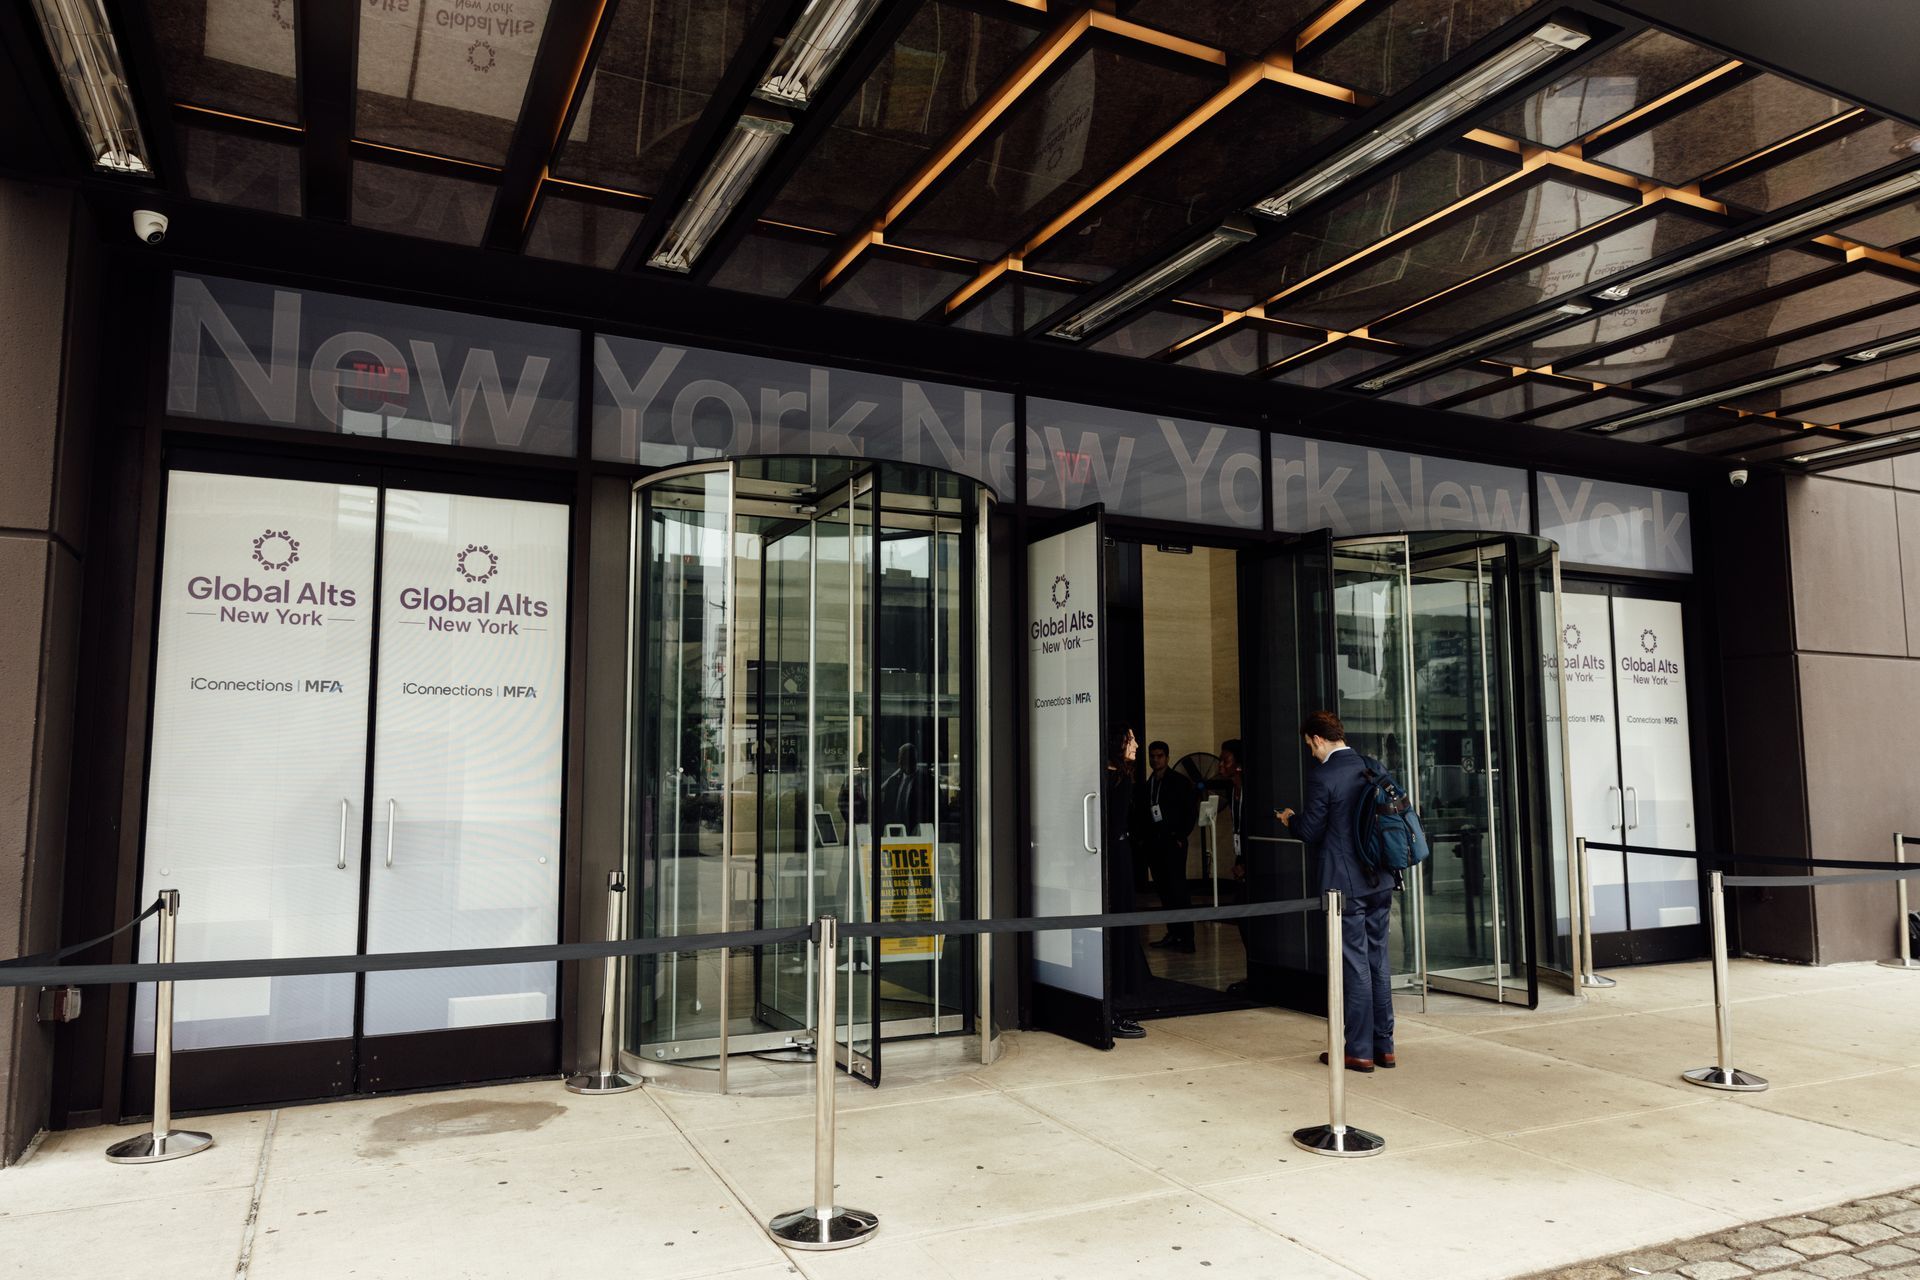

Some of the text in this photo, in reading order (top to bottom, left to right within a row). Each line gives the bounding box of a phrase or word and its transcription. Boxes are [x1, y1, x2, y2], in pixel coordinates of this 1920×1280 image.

[166, 275, 1689, 569] New York New York New York
[187, 576, 356, 607] Global Alts
[400, 587, 548, 617] Global Alts
[220, 606, 323, 626] New York
[1031, 610, 1094, 640] Global Alts
[428, 616, 519, 635] New York
[1042, 636, 1081, 654] New York
[1582, 655, 1605, 670] Alts
[1622, 657, 1679, 674] Global Alts
[190, 676, 343, 694] iConnections MFA
[1575, 672, 1594, 682] York
[1633, 674, 1668, 685] New York
[402, 682, 537, 699] iConnections MFA
[1034, 692, 1091, 709] iConnections MFA
[1590, 715, 1605, 723] MFA
[1664, 717, 1678, 725] MFA
[882, 849, 930, 869] OTICE
